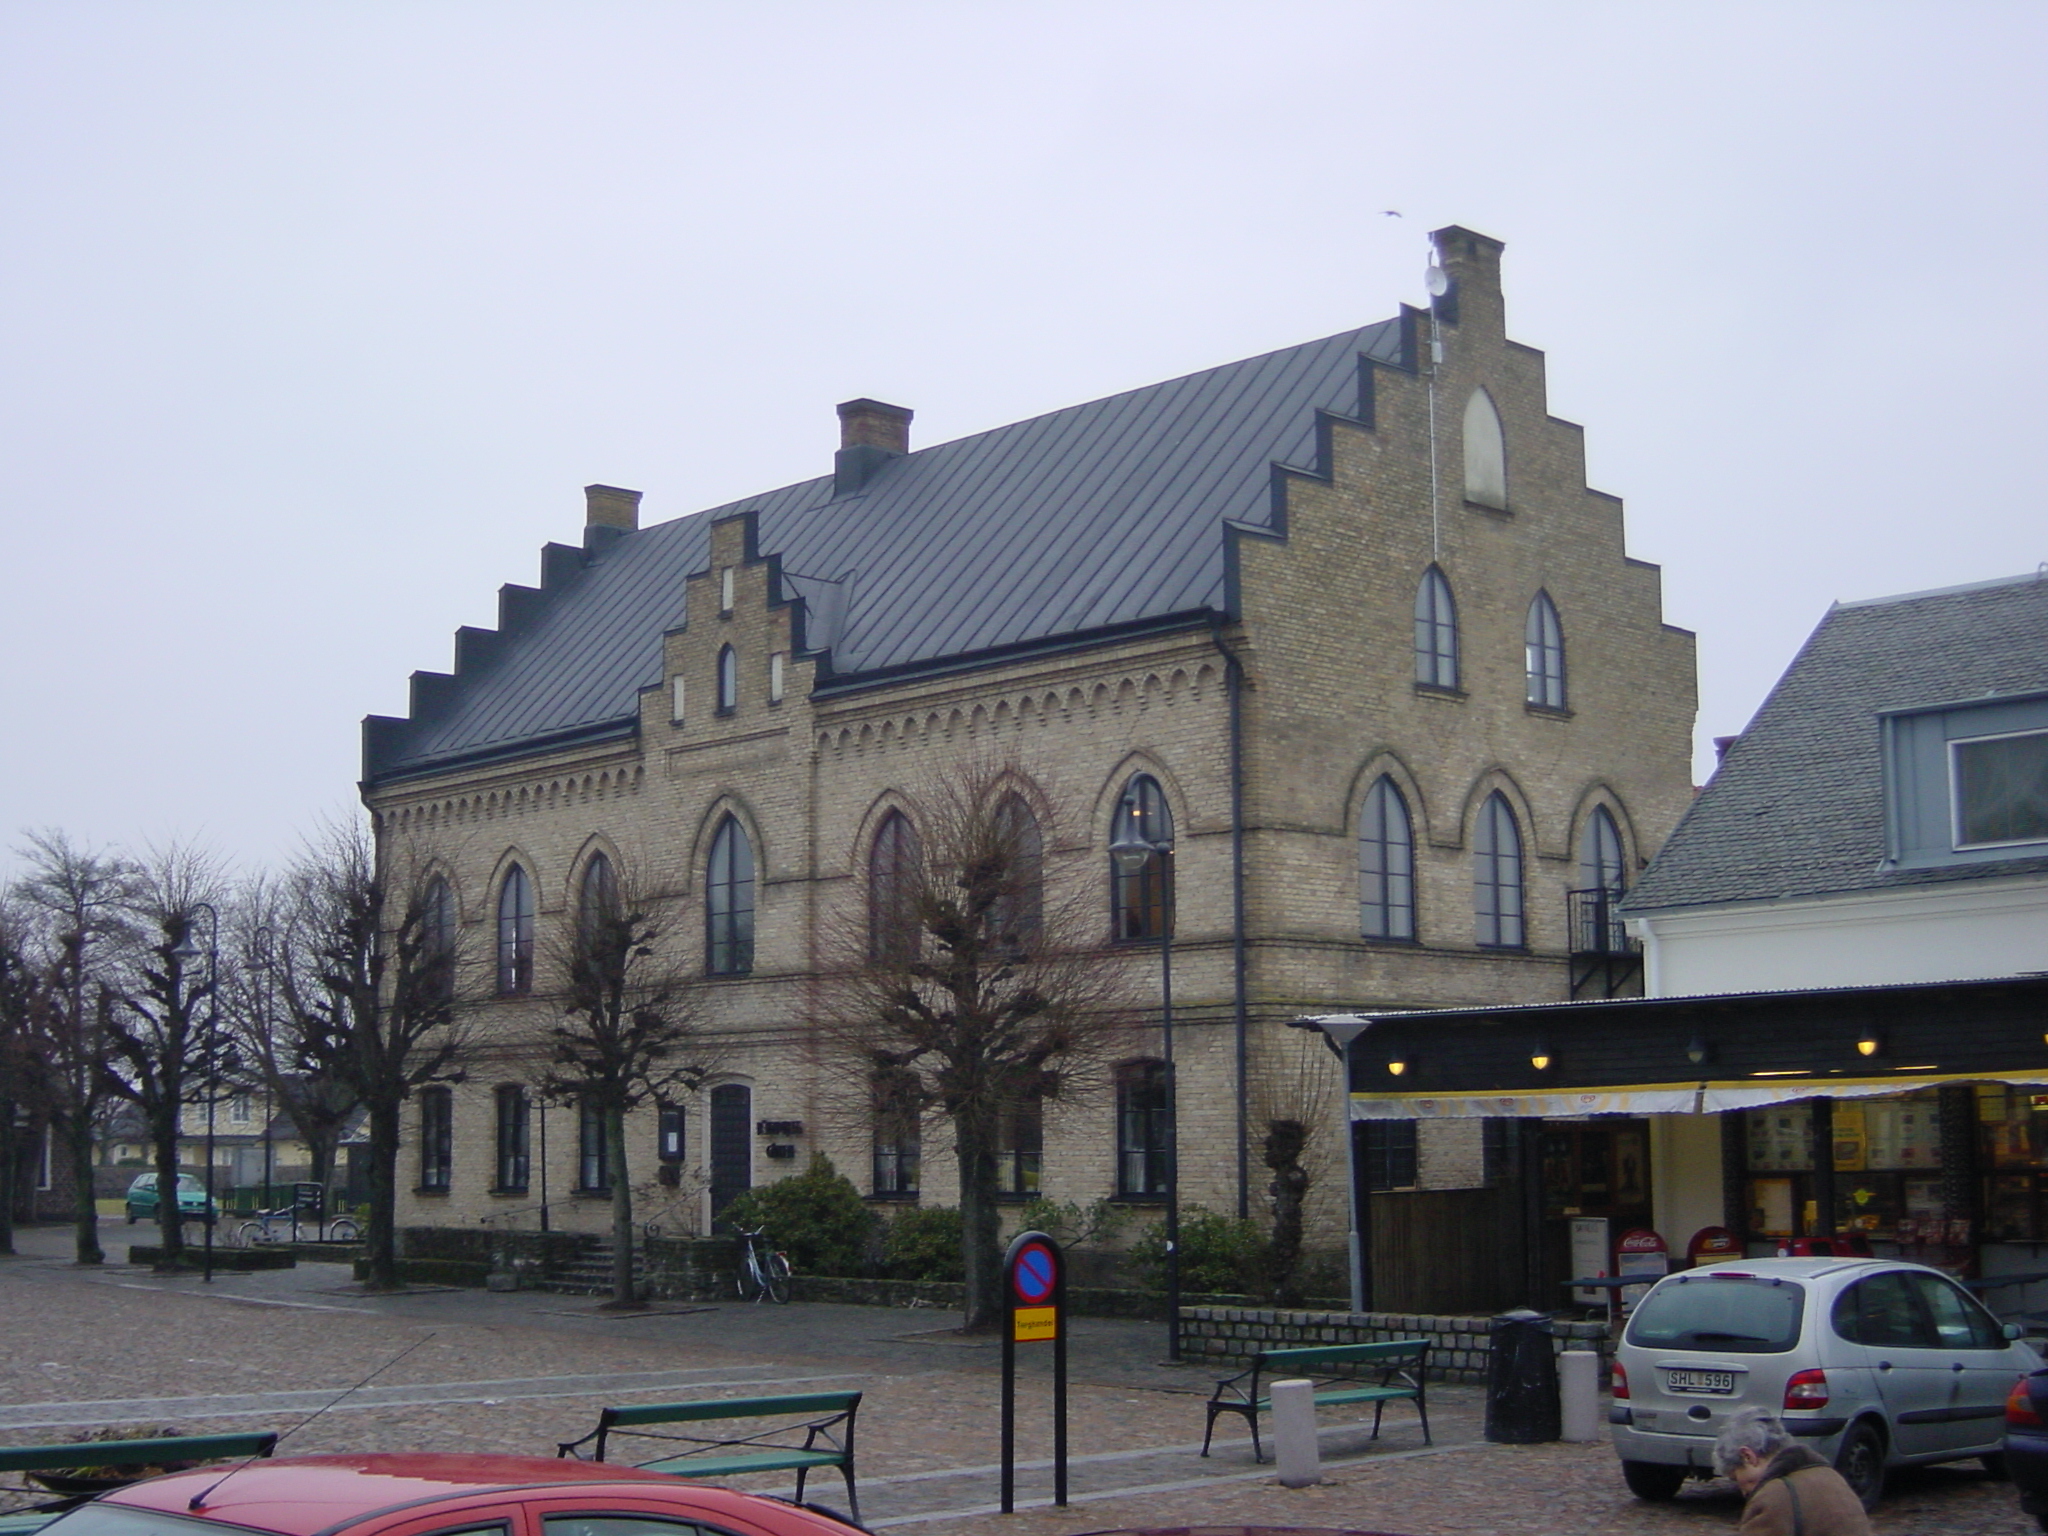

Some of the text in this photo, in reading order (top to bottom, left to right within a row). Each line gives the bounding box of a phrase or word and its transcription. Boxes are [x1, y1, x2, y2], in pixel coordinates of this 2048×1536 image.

[1624, 1236, 1657, 1247] Coca-Cola
[1670, 1372, 1730, 1387] SHL 596
